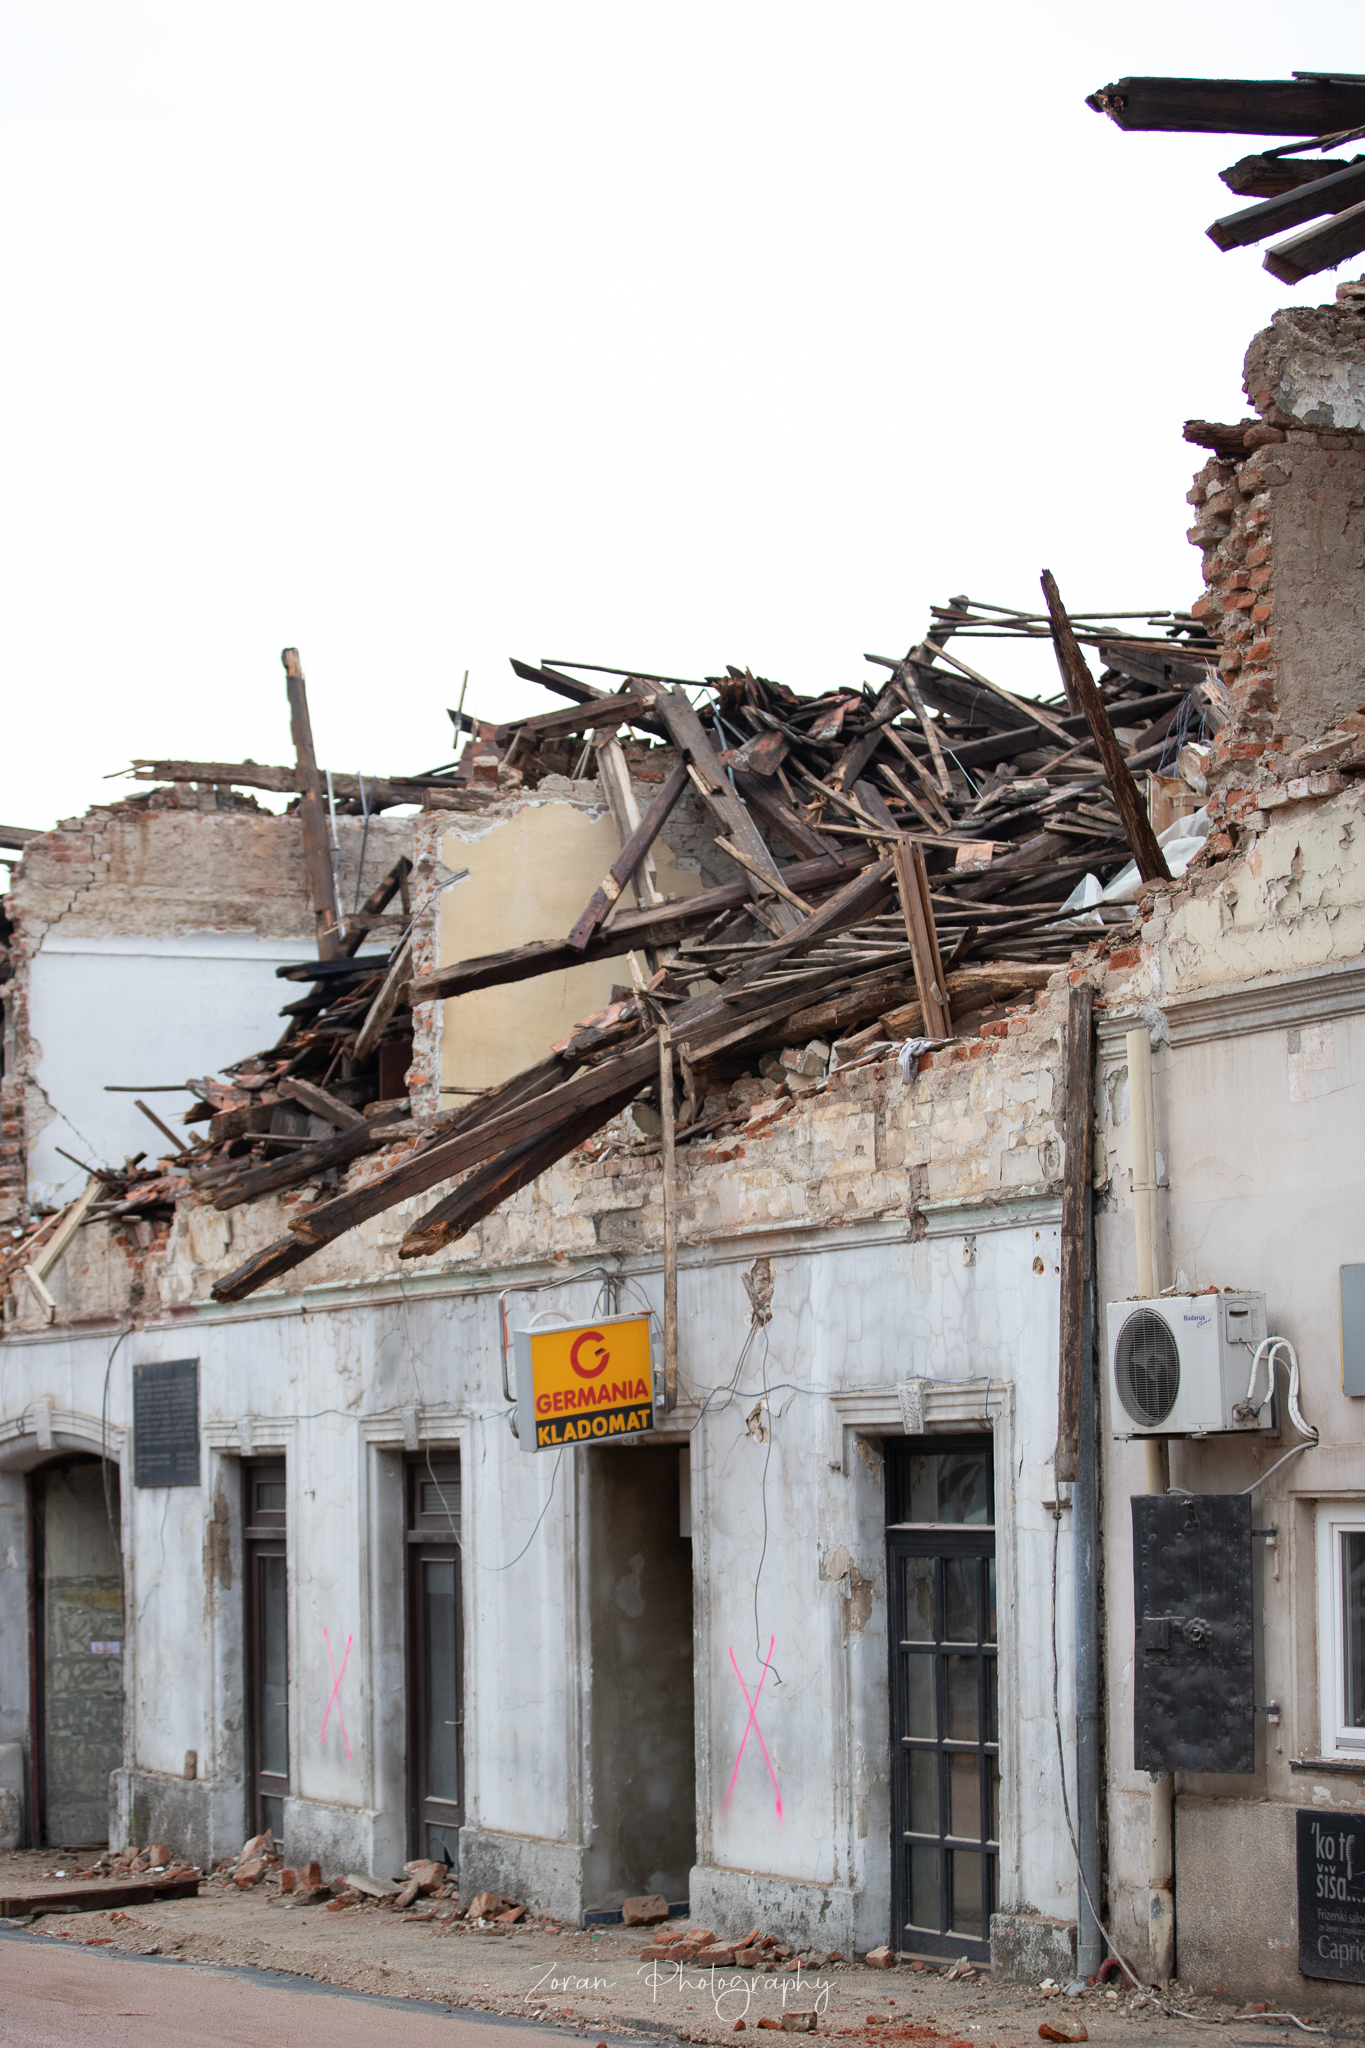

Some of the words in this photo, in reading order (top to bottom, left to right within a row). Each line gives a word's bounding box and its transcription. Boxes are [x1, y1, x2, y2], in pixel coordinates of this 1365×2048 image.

[536, 1378, 649, 1414] GERMANIA
[538, 1409, 650, 1446] KLADOMAT
[1317, 1907, 1347, 1922] Frizerski
